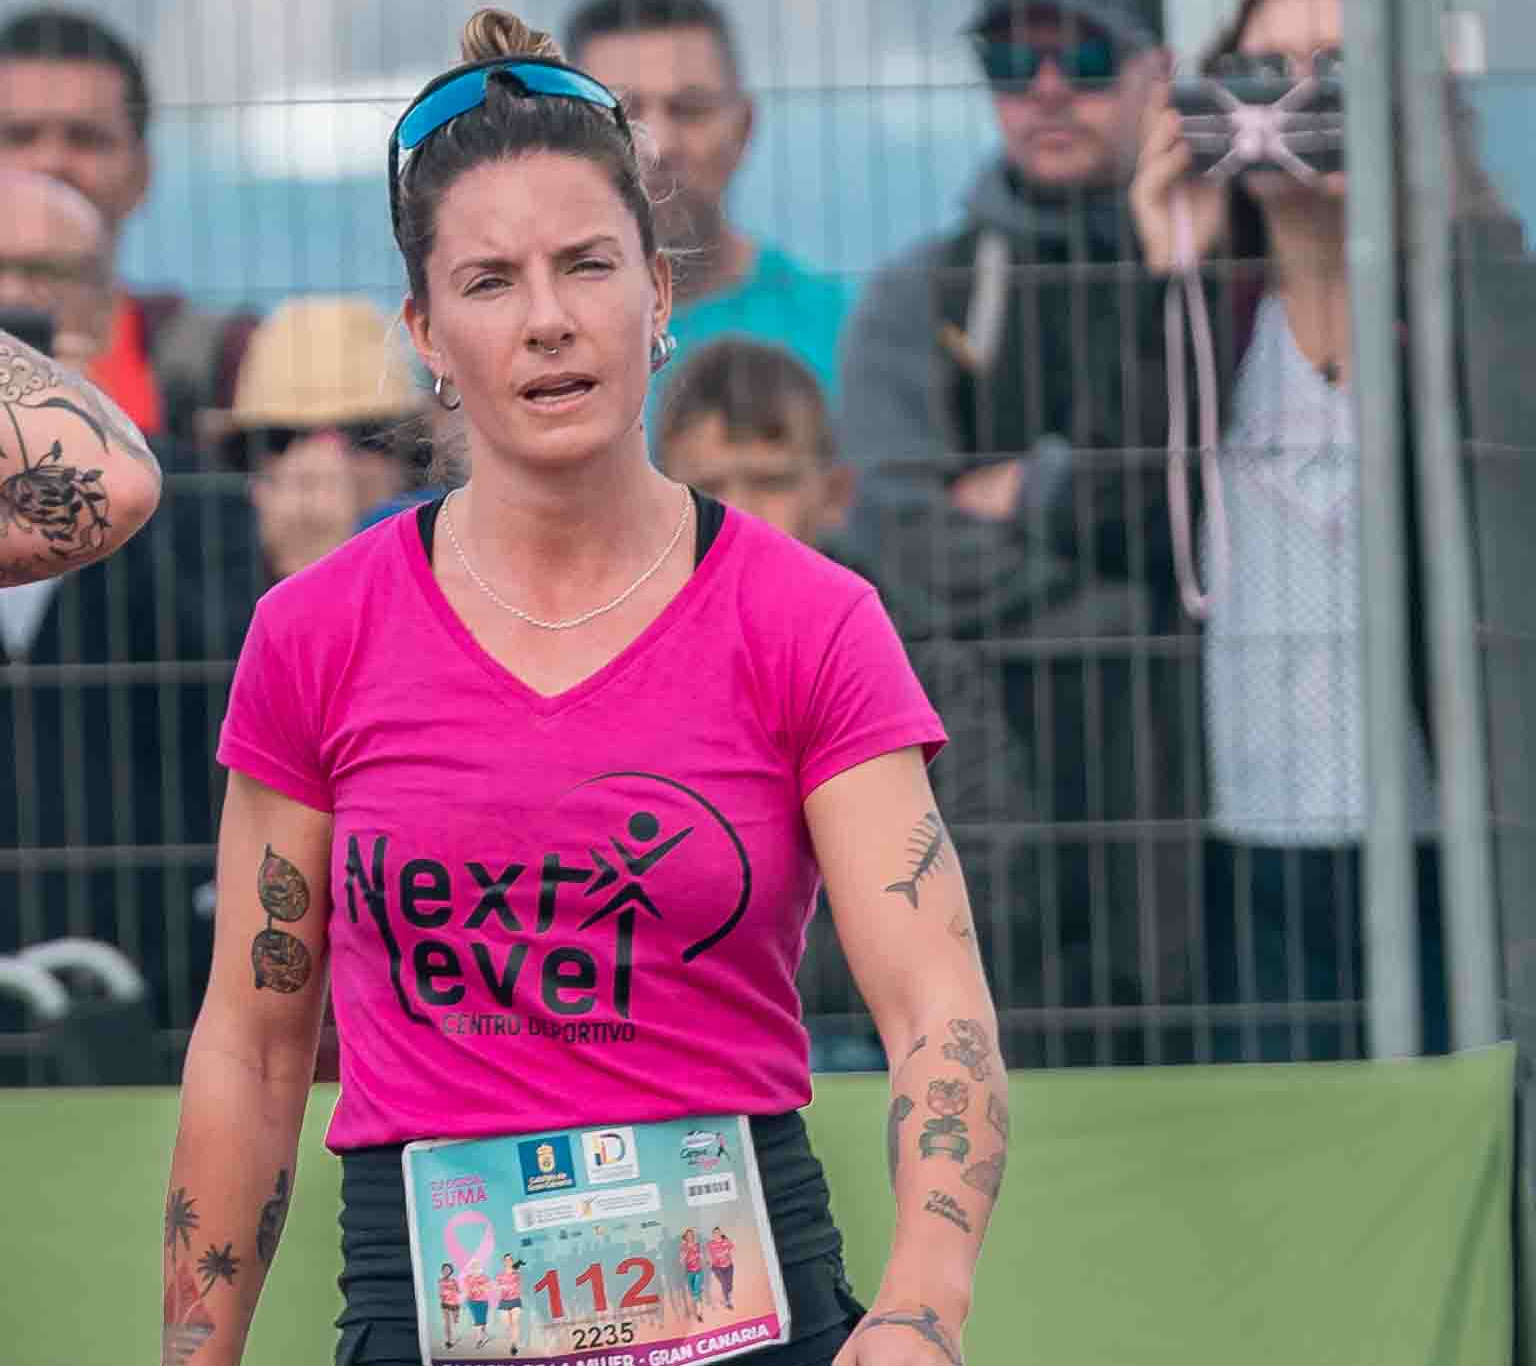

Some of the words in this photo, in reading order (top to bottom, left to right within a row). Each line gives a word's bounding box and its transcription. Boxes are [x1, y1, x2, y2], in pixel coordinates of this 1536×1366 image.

[345, 835, 600, 934] Next
[378, 905, 635, 1028] Level
[442, 1013, 522, 1037] CENTRO
[528, 1018, 637, 1045] DEPORTIVO
[431, 1186, 488, 1210] SUMA
[533, 1256, 661, 1319] 112
[571, 1321, 635, 1351] 2235
[696, 1322, 770, 1354] CANARIA
